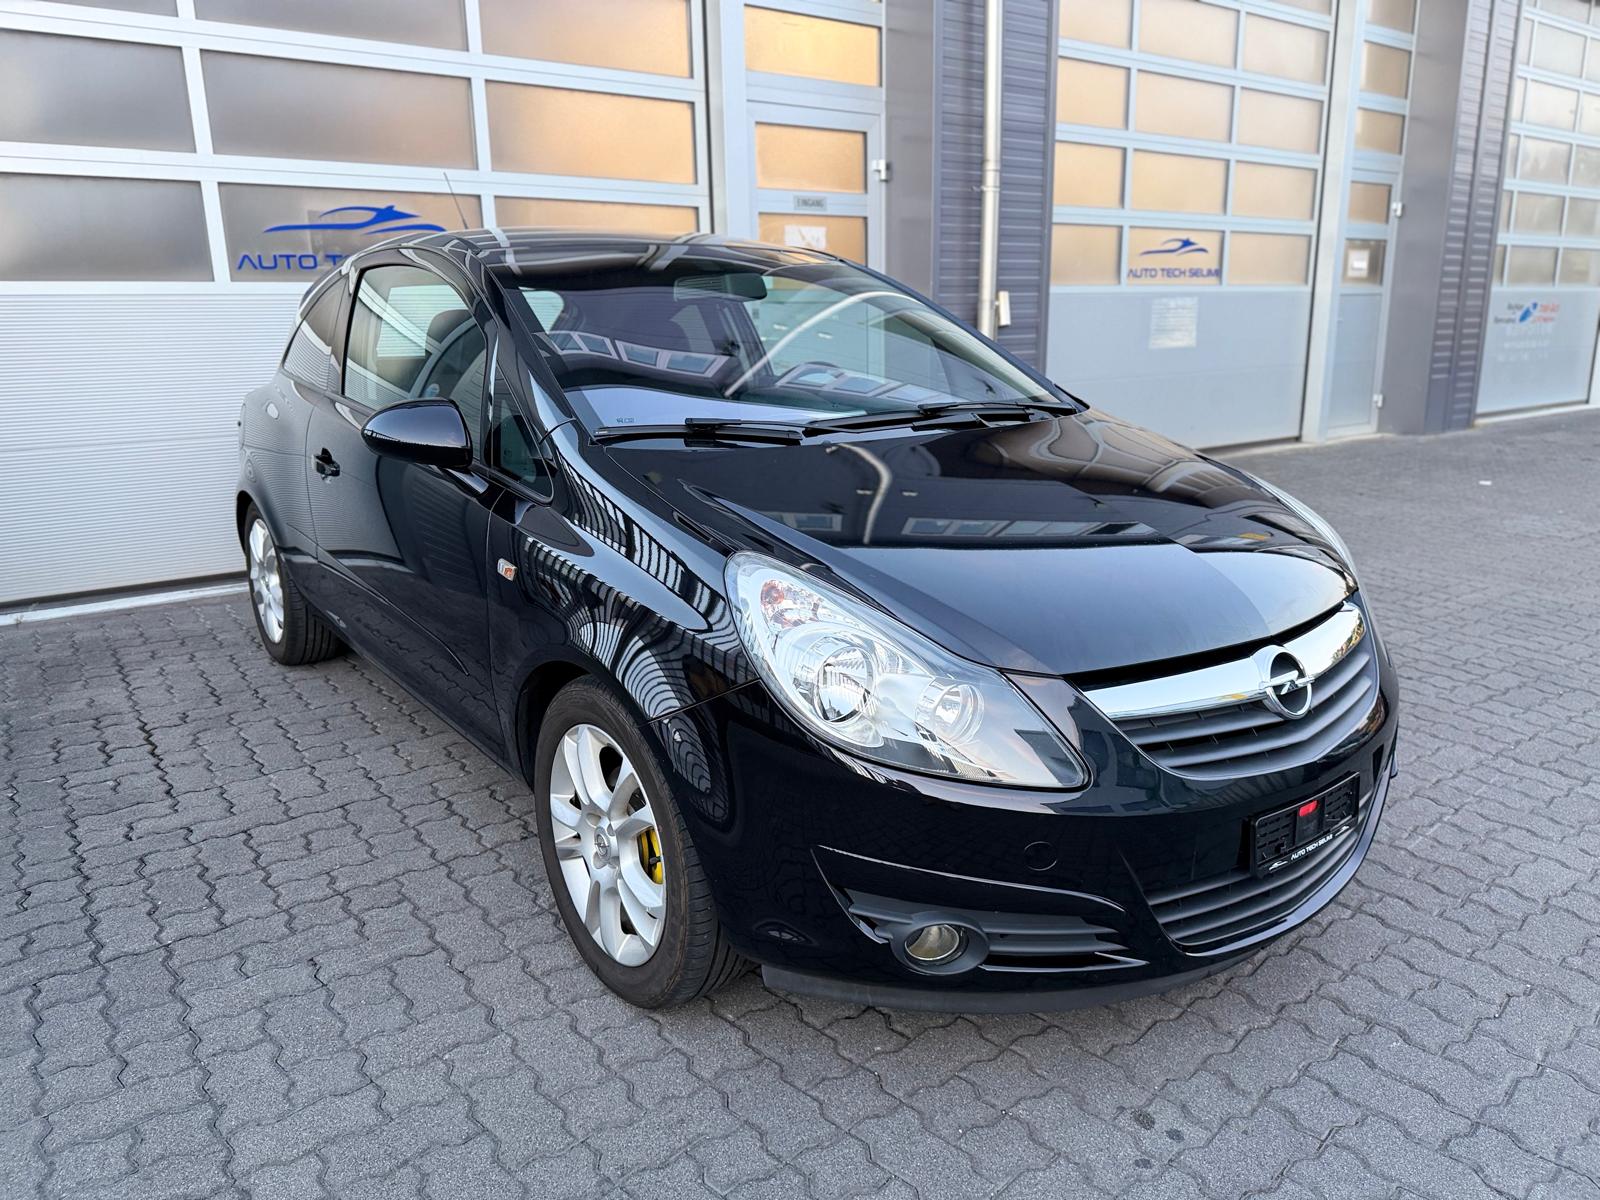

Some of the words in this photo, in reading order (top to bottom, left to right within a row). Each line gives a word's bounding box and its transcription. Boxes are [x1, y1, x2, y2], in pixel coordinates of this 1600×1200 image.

[237, 254, 318, 270] AUTO
[1128, 268, 1157, 278] AUTO
[1160, 268, 1186, 278] TECH
[1291, 849, 1305, 860] AUTO
[1306, 843, 1318, 852] TECH
